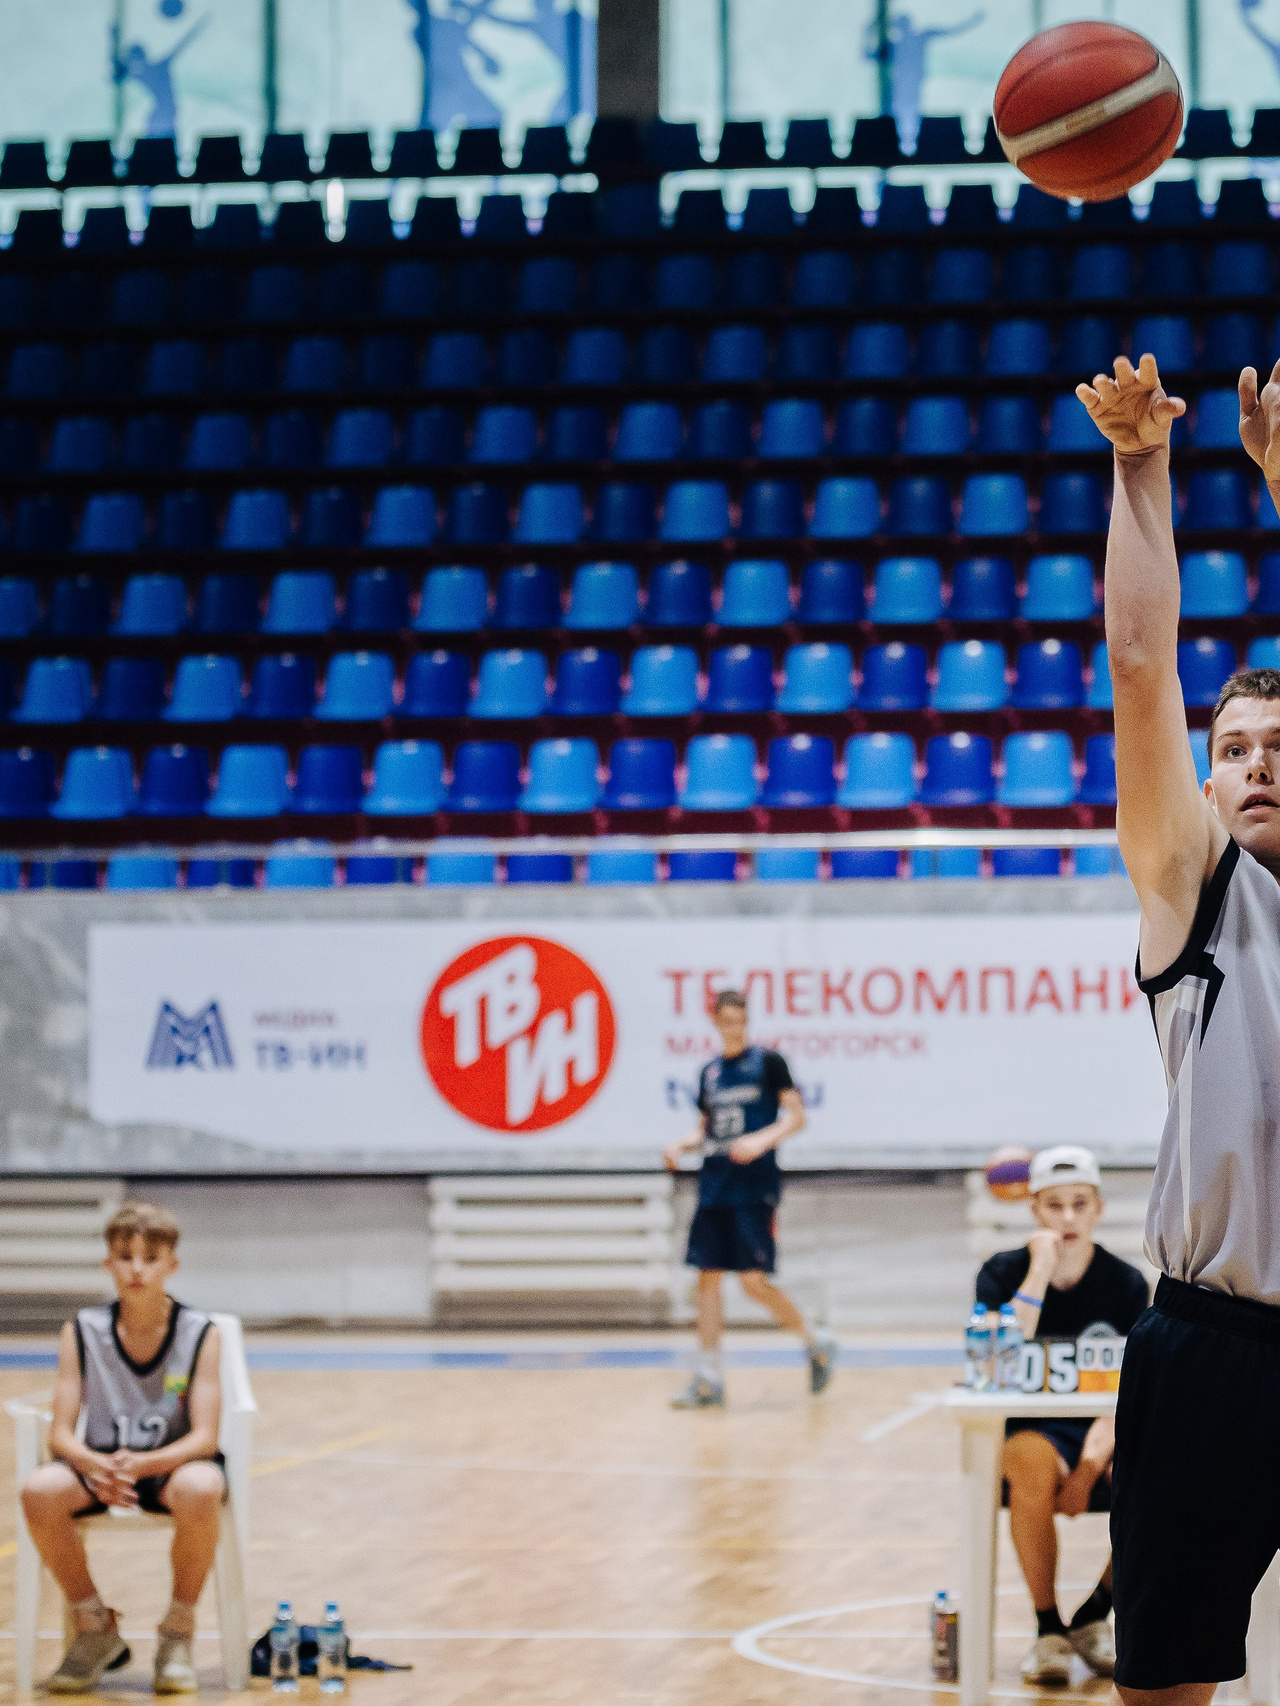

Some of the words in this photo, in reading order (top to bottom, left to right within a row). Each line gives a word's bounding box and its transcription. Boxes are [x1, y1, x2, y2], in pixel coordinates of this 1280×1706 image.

[439, 942, 539, 1069] ТВ
[662, 966, 1139, 1017] ТЕЛЕКОМПАНИ
[505, 989, 599, 1126] ИН
[1020, 1341, 1079, 1394] 05
